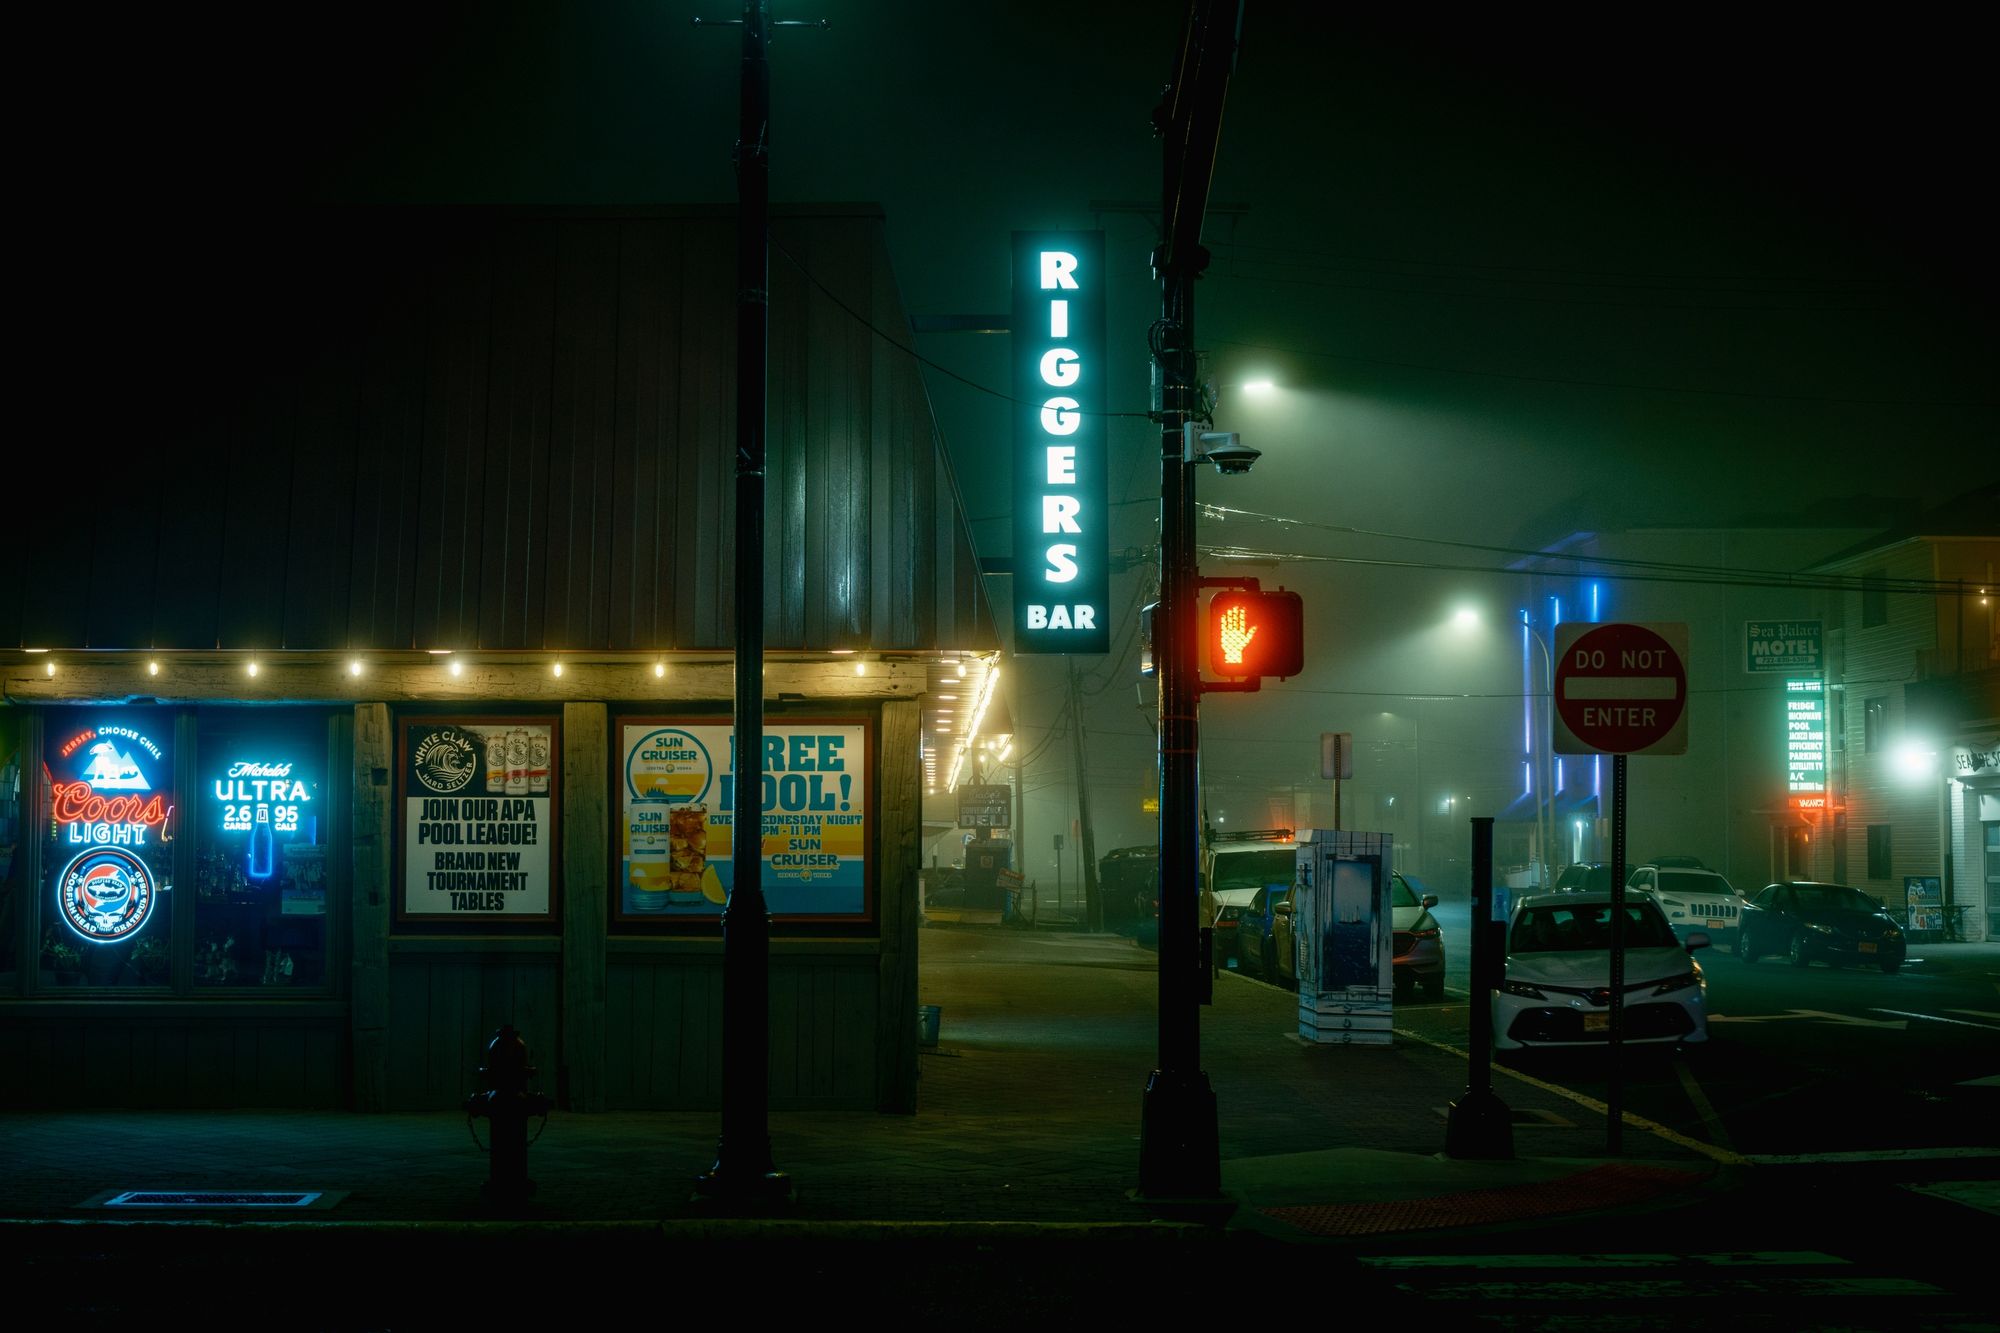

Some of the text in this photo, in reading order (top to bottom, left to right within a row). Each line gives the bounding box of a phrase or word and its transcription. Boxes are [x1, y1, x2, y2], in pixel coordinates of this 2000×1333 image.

[1039, 251, 1082, 584] RIGGERS
[1026, 604, 1096, 630] BAR
[1750, 624, 1819, 639] Sea Palace
[1752, 640, 1819, 656] MOTEL
[1576, 650, 1666, 669] DO NOT
[1788, 702, 1815, 710] FRIDGE
[1583, 708, 1656, 727] ENTER
[1788, 712, 1821, 720] MICROWAVE
[1789, 722, 1810, 730] POOL
[62, 727, 162, 760] JERSEY, CHOOSE CHILL
[414, 731, 474, 767] WHITE CLAW
[656, 737, 683, 747] SUN
[1789, 742, 1823, 750] EFFICIENCY
[641, 750, 697, 760] CRUISER
[729, 735, 845, 771] REE
[1789, 752, 1822, 760] PARKING
[228, 762, 292, 777] Michelob
[1789, 762, 1823, 770] SATELLITE TV
[422, 773, 443, 789] HARD
[446, 762, 473, 789] SELTZER
[1790, 772, 1804, 781] A/C
[215, 779, 309, 801] ULTRA
[54, 781, 165, 825] Coors
[421, 799, 536, 821] JOIN OUR APA
[1799, 799, 1824, 807] VACANCY
[224, 804, 252, 822] 2.6
[274, 805, 298, 822] 95
[638, 812, 662, 822] SUN
[762, 815, 823, 825] EDNESDAY
[827, 815, 863, 825] NIGHT
[70, 822, 147, 844] LIGHT
[223, 822, 252, 830] CARBS
[275, 822, 297, 831] CALS
[419, 823, 537, 845] POOL LEAGUE!
[804, 826, 821, 835] PM
[789, 838, 821, 850] SUN
[435, 852, 520, 871] BRAND NEW
[771, 854, 838, 866] CRUISER
[427, 872, 528, 891] TOURNAMENT
[66, 871, 97, 933] DOGFISH HEAD
[114, 871, 148, 933] GRATEFUL DEAD
[450, 892, 505, 911] TABLES
